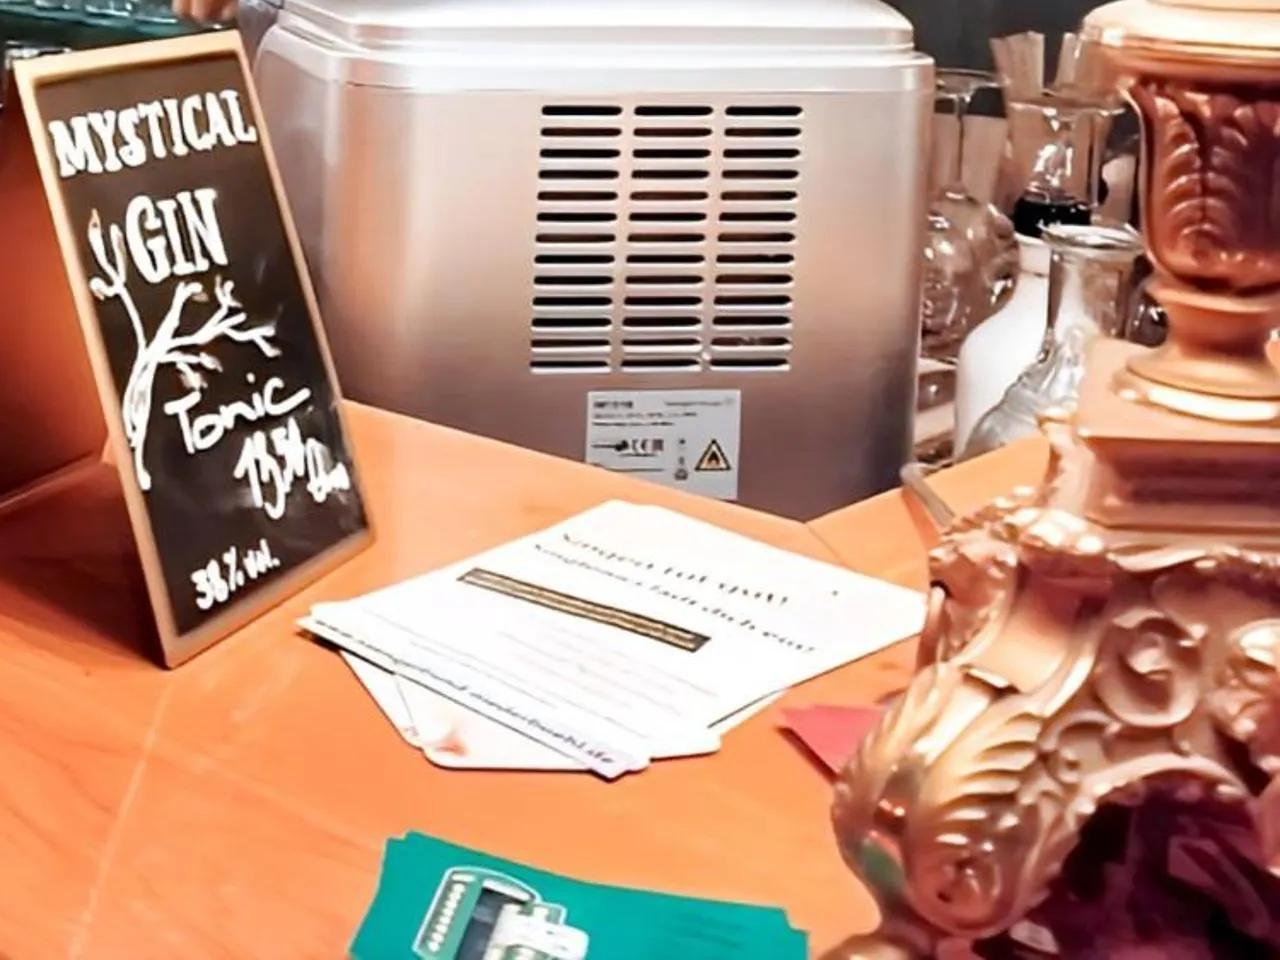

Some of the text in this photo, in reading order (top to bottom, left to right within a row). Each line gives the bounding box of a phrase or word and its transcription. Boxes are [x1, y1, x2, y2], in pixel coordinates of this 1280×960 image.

[47, 88, 258, 179] MYSTICAL
[125, 187, 230, 284] GIN
[163, 371, 312, 455] Tonic
